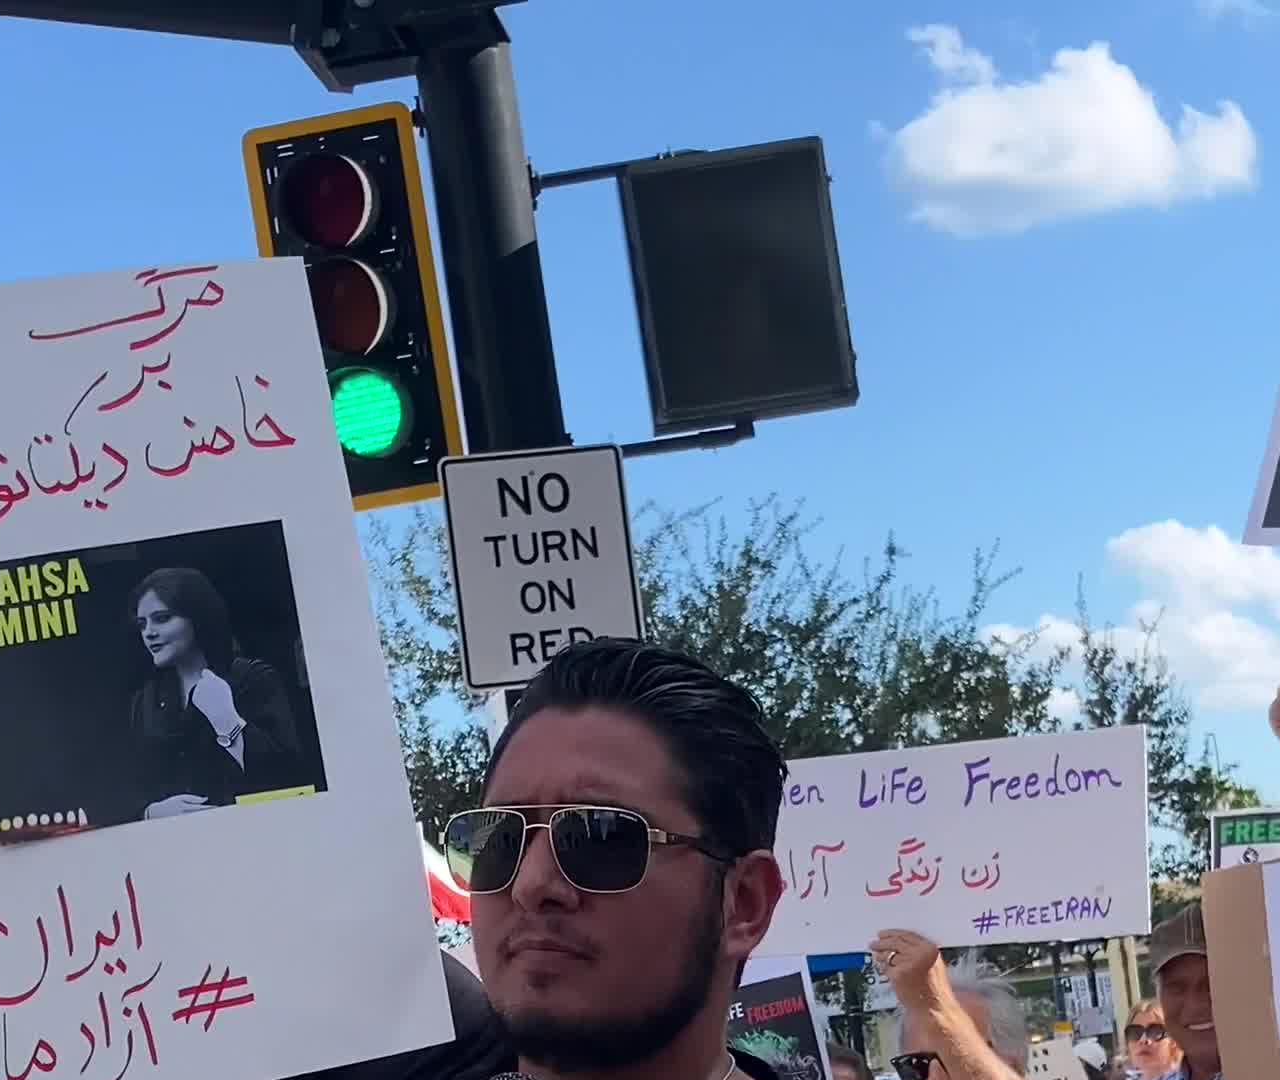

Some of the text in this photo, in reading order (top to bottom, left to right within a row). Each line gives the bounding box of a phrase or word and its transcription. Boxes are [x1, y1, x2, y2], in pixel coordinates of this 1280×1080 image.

[29, 266, 224, 349] مرگ
[496, 471, 570, 517] NO
[484, 526, 599, 568] TURN
[520, 578, 576, 614] ON
[964, 752, 1123, 808] Freedom
[782, 837, 1002, 899] زن زندگی آزا
[972, 896, 1113, 935] #FREEIRAN
